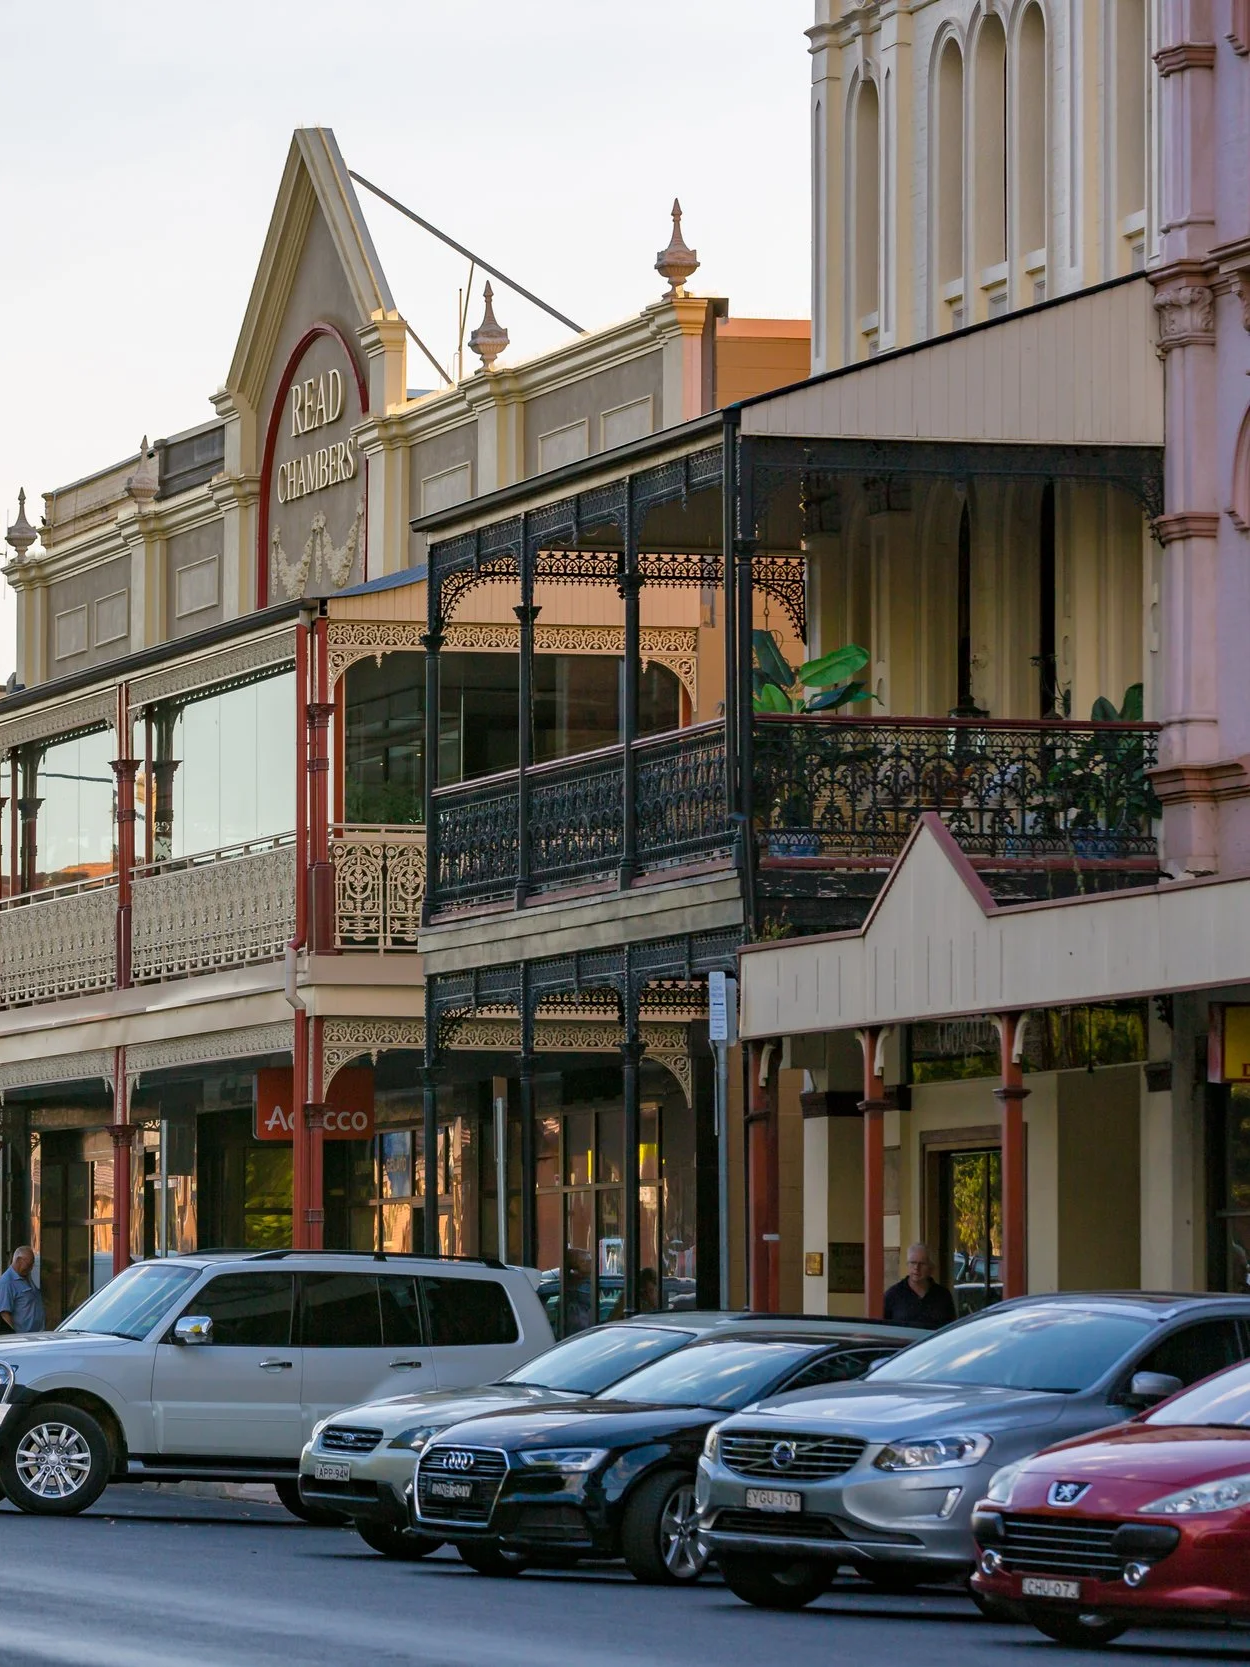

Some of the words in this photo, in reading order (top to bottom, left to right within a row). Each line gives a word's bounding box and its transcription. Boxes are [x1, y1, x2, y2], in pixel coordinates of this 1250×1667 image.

[291, 368, 343, 437] READ
[277, 438, 355, 504] CHAMBERS
[264, 1105, 368, 1132] Acco
